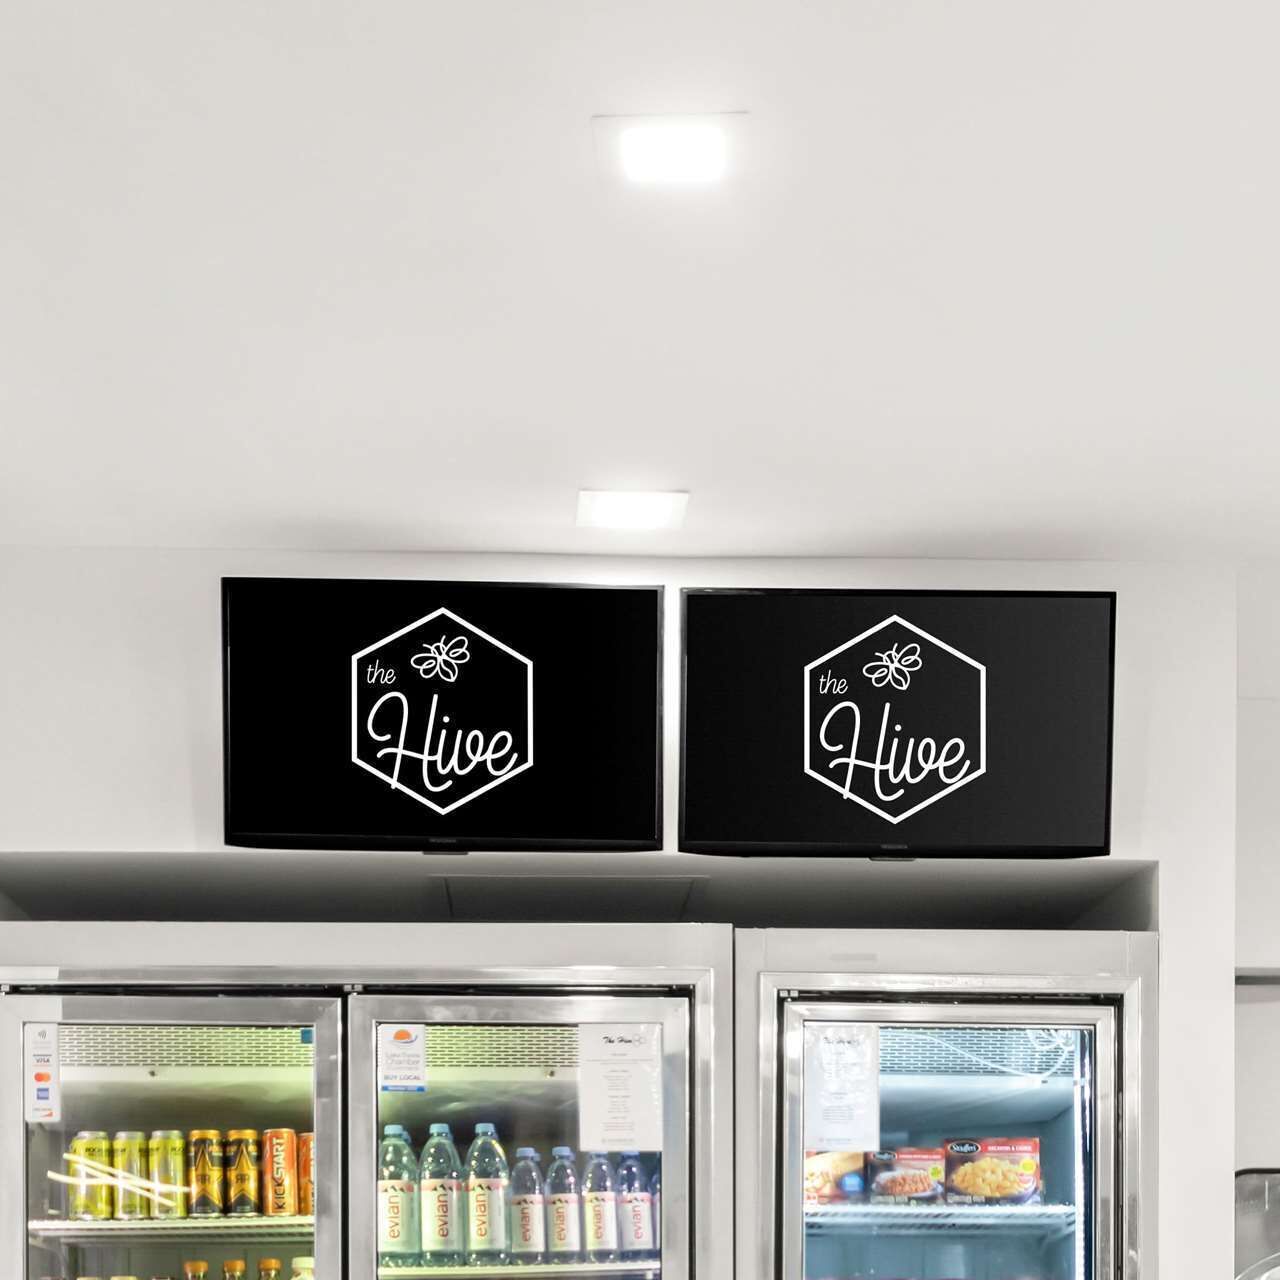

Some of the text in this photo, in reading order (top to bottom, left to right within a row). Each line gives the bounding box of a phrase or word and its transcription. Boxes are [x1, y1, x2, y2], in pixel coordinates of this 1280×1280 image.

[366, 658, 397, 686] the
[818, 669, 849, 697] the
[366, 690, 519, 792] Hive
[819, 701, 971, 801] Hive
[273, 1137, 287, 1211] KICKSTART
[388, 1193, 400, 1240] evian
[436, 1192, 449, 1239] evian
[477, 1191, 489, 1239] evian
[522, 1205, 531, 1243] evian
[557, 1205, 568, 1242] evian
[593, 1203, 603, 1239] evian
[634, 1203, 643, 1240] evian
